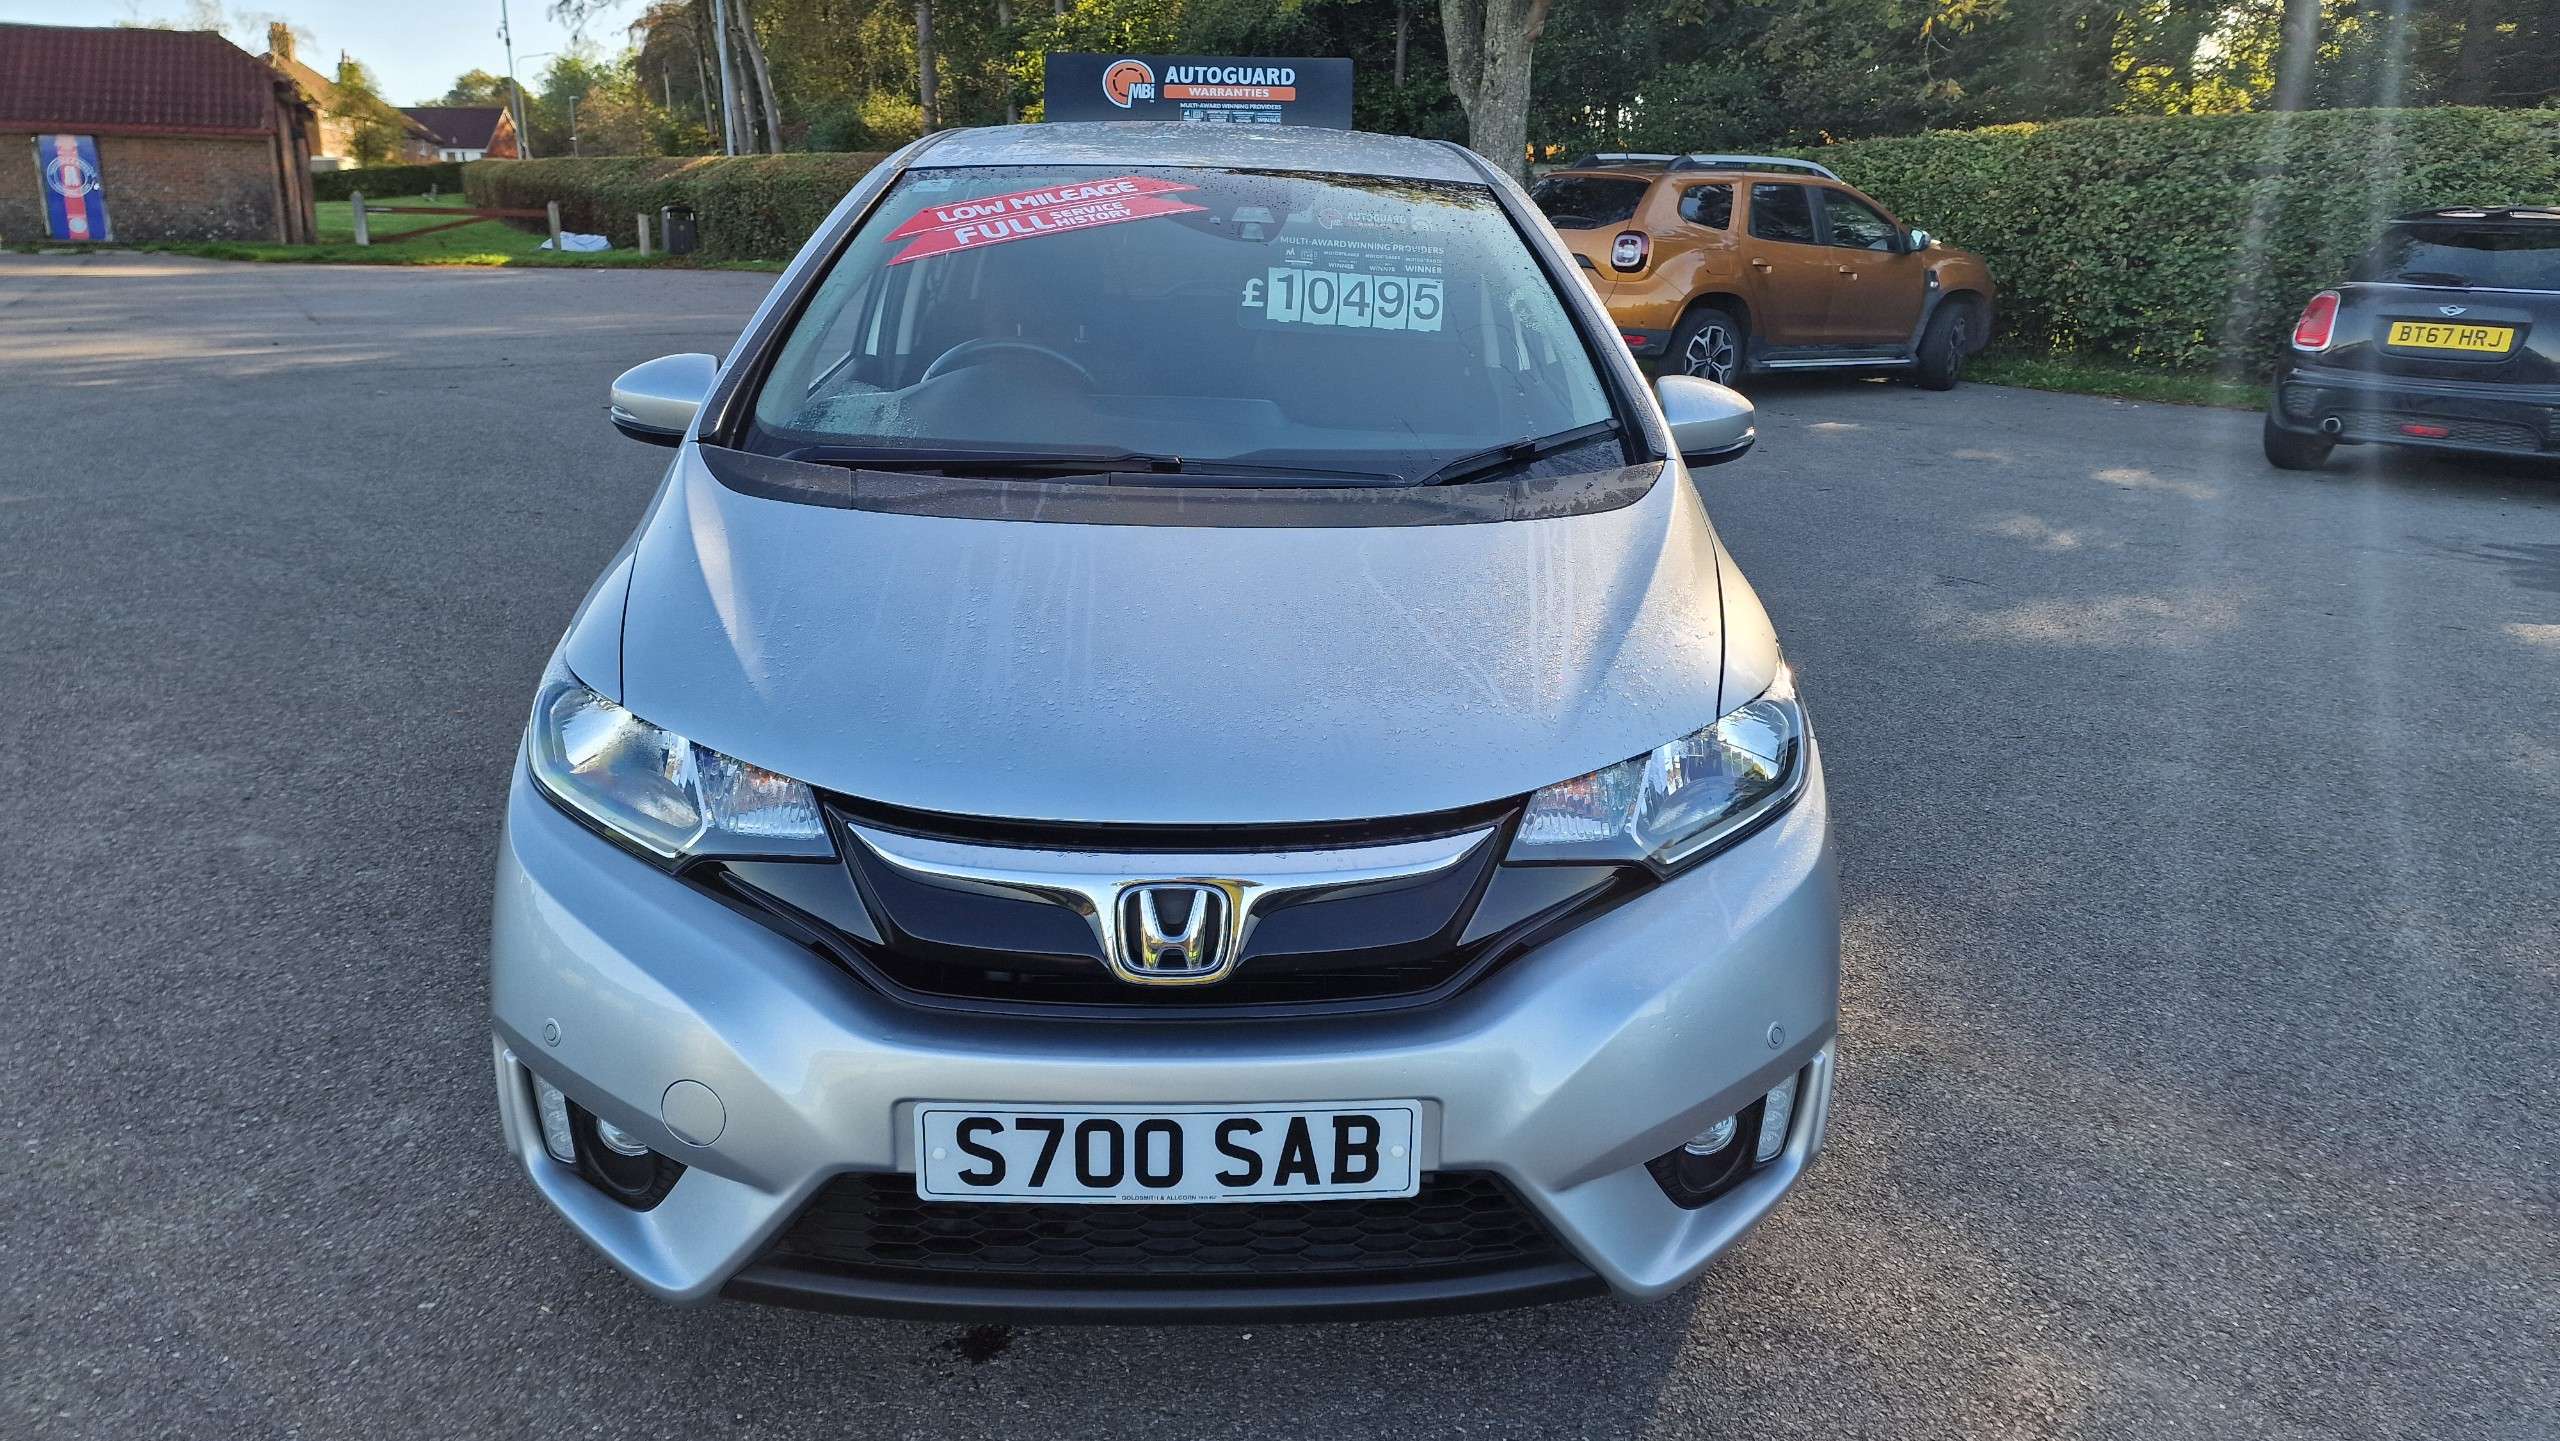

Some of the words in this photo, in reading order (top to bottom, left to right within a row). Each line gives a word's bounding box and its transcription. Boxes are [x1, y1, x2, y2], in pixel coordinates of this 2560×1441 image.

[1165, 66, 1296, 86] AUTOGUARD
[1188, 87, 1270, 98] WARRANTIES
[937, 200, 1004, 224] LOW
[1010, 181, 1139, 209] MILEAGE
[1053, 201, 1124, 220] SERVICE
[1058, 208, 1133, 228] HISTORY
[954, 212, 1056, 245] FULL
[1279, 236, 1347, 248] MULTI-AWARD
[1347, 240, 1391, 252] WINNING
[1392, 243, 1445, 255] PROVIDERS
[1328, 262, 1355, 270] WINNER
[1405, 265, 1443, 274] WINNER
[2398, 325, 2456, 346] BT67
[2458, 328, 2504, 348] HRJ
[956, 1116, 1184, 1189] S700
[1214, 1114, 1381, 1188] SAB
